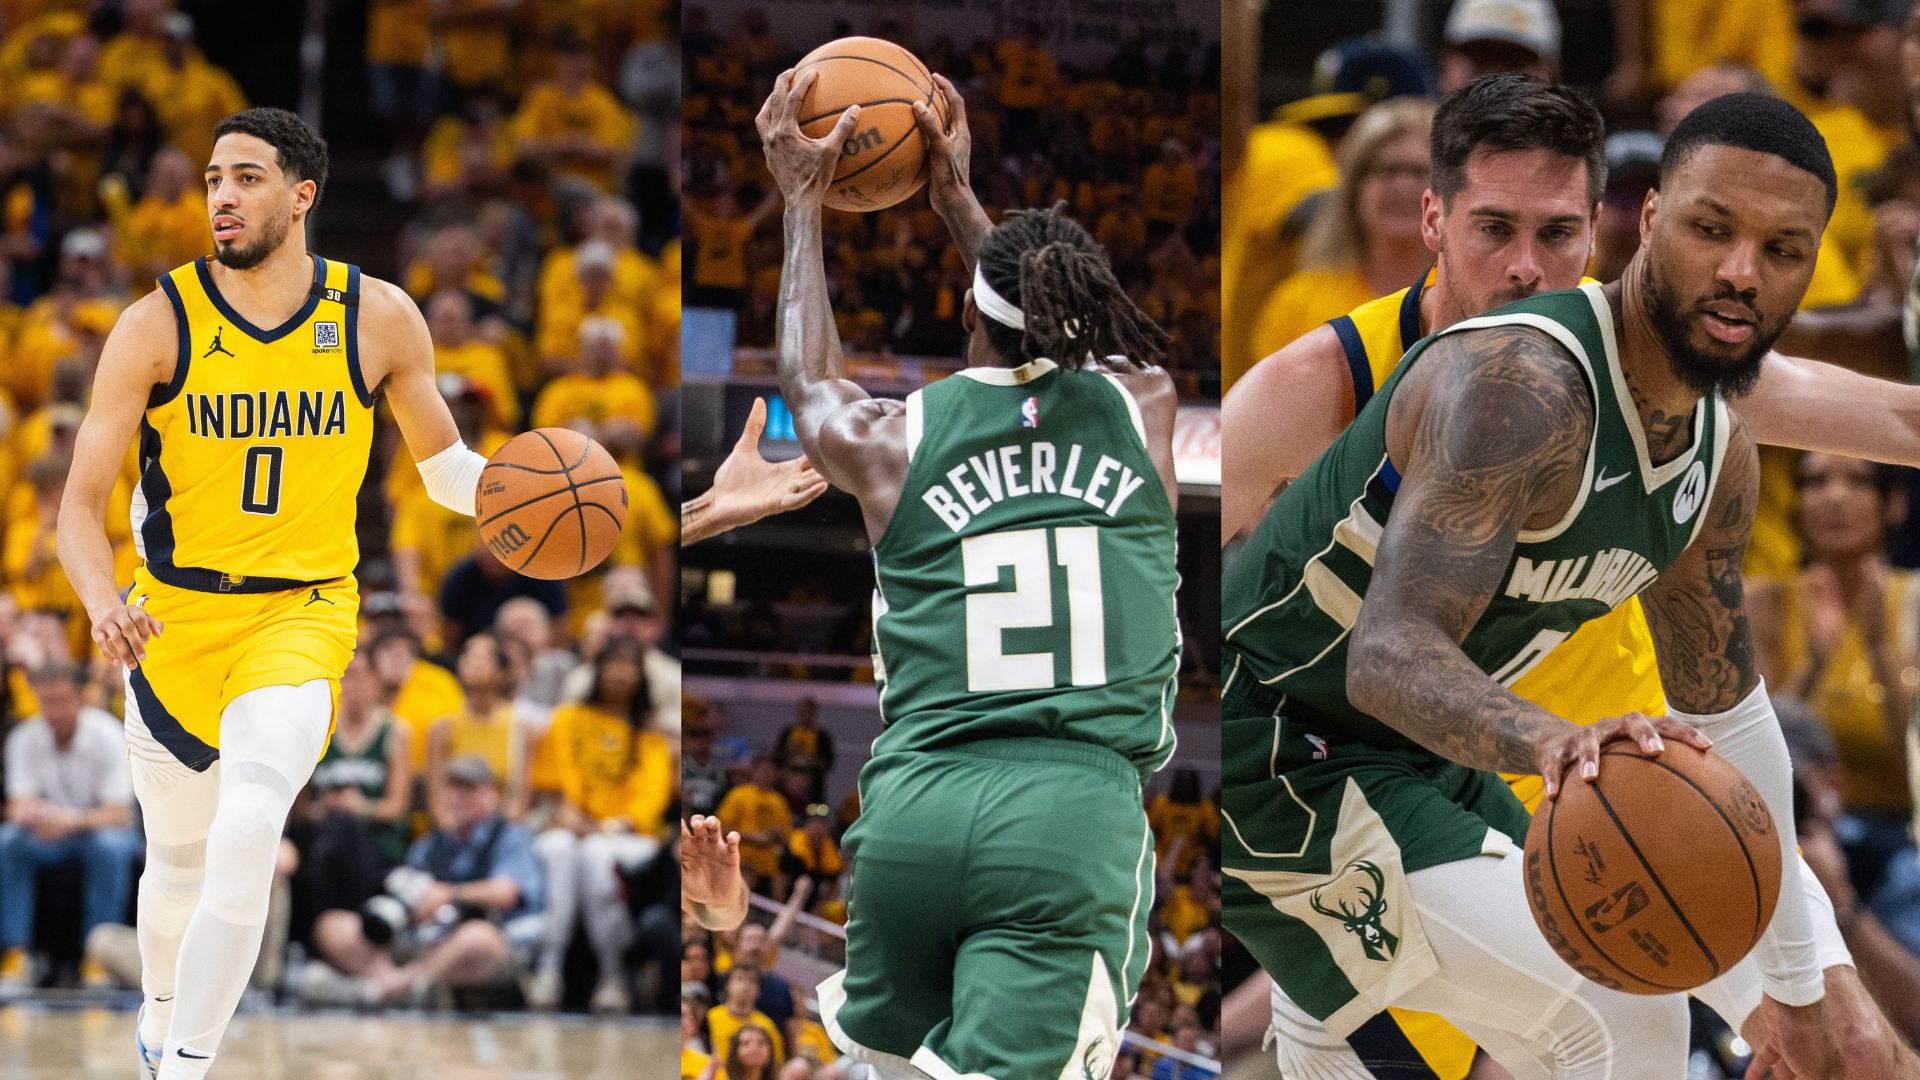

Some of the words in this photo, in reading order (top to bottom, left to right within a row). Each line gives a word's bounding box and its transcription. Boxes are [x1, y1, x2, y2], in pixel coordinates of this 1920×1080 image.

[326, 289, 341, 302] 30
[185, 389, 347, 440] INDIANA
[240, 444, 284, 516] 0
[921, 441, 1145, 533] BEVERLEY
[961, 526, 1107, 692] 21
[1504, 547, 1659, 611] MILWAUK
